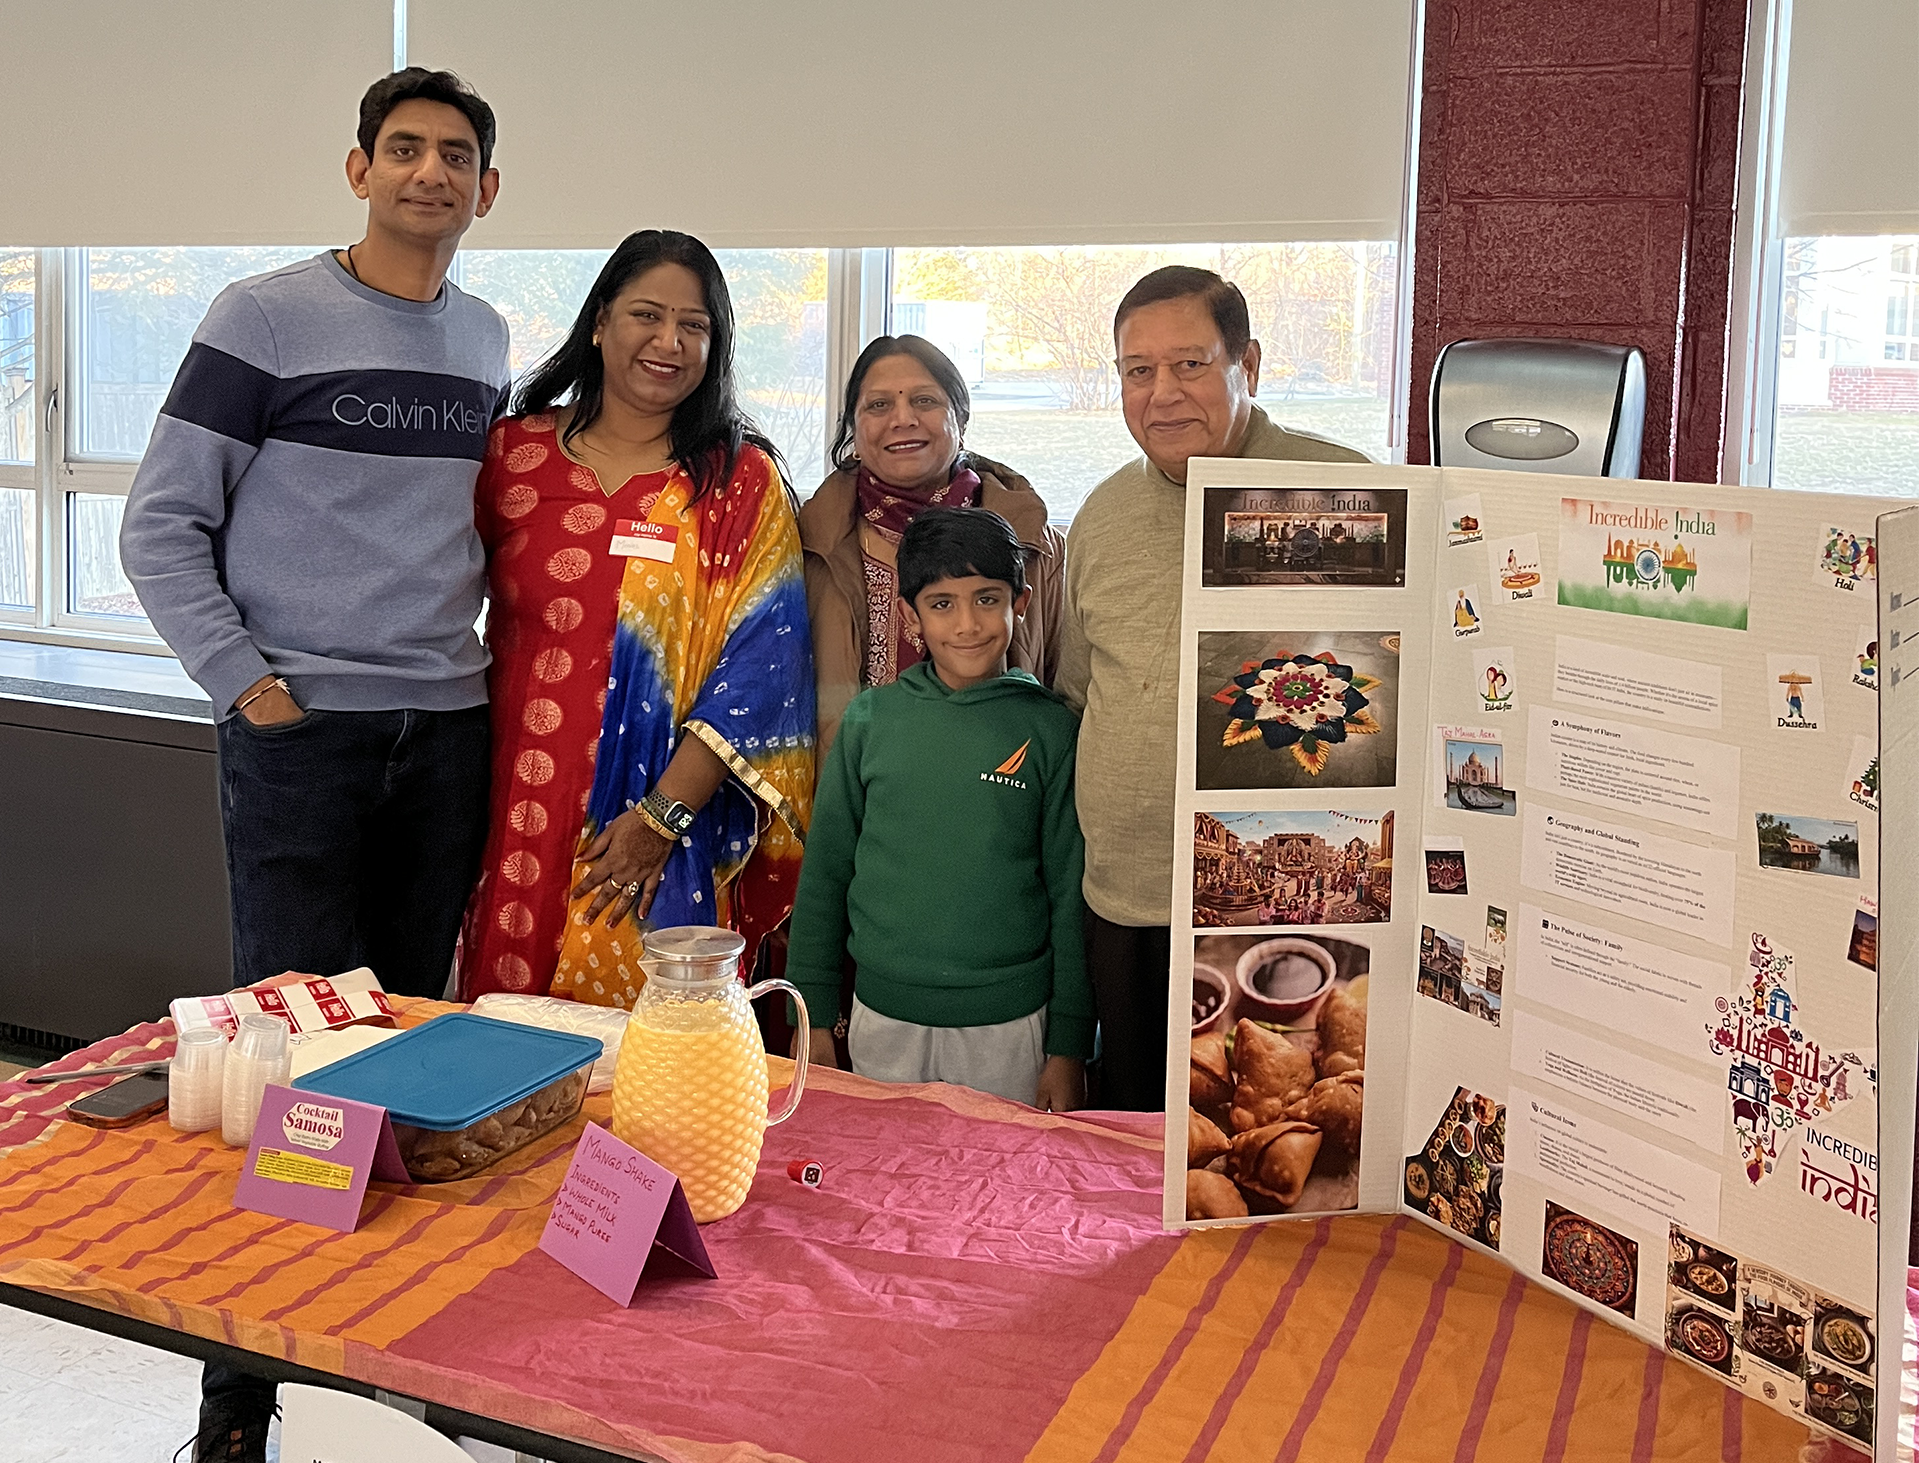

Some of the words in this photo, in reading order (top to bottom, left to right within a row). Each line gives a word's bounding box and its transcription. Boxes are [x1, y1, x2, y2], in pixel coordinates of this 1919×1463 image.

[332, 394, 436, 430] Calvin
[1241, 493, 1325, 511] Incredible
[631, 521, 663, 534] Hello
[1588, 504, 1669, 531] Incredible
[1834, 577, 1854, 591] Holi
[1560, 720, 1566, 728] A
[1566, 721, 1594, 735] Symphony
[1600, 727, 1621, 739] Flavors
[1777, 716, 1817, 730] Dussehra
[981, 772, 1026, 789] NAUTICA
[1555, 818, 1583, 834] Geography
[1584, 827, 1595, 836] and
[1595, 829, 1613, 841] Global
[1614, 834, 1640, 848] Standing
[1550, 922, 1560, 932] The
[1561, 926, 1575, 937] Pulse
[1575, 931, 1582, 939] of
[1604, 939, 1623, 952] Family
[296, 1103, 339, 1122] Cocktail
[1539, 1106, 1562, 1122] Cultural
[284, 1111, 343, 1139] Samosa
[583, 1135, 622, 1171] MANGO
[624, 1156, 656, 1192] SHAKE
[570, 1164, 621, 1205] INGREDIENTS
[569, 1187, 595, 1208] WHOLE
[563, 1201, 587, 1225] MANGO
[555, 1214, 580, 1240] SUGAR
